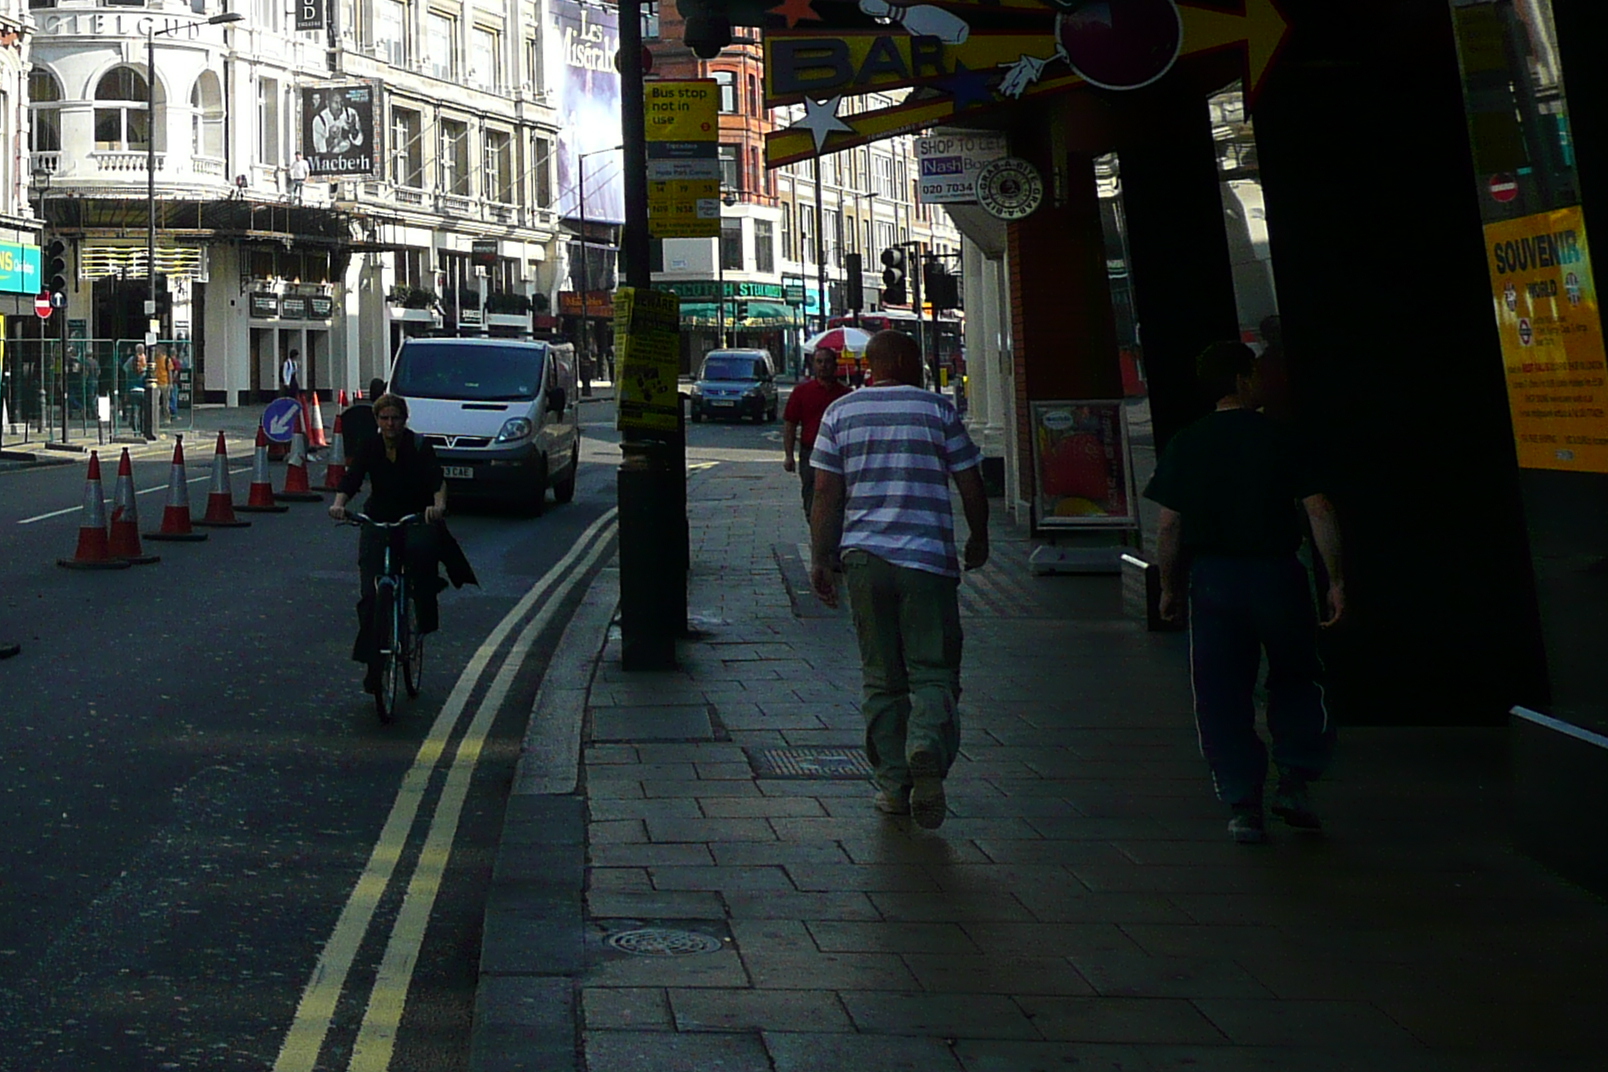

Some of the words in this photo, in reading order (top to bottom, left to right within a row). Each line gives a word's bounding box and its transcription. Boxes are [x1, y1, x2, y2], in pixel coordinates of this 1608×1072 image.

[44, 13, 200, 41] GIELGUD
[579, 9, 603, 43] Les
[770, 34, 948, 95] BAR
[651, 87, 675, 99] Bus
[678, 88, 708, 101] stop
[651, 101, 675, 112] not
[678, 101, 690, 112] in
[652, 114, 675, 125] use
[920, 139, 954, 156] SHOP
[958, 138, 975, 153] TO
[979, 137, 1003, 150] LET
[923, 157, 963, 175] Nash
[922, 184, 943, 195] 020
[945, 182, 973, 193] 7034
[1493, 229, 1581, 274] SOUVENIR
